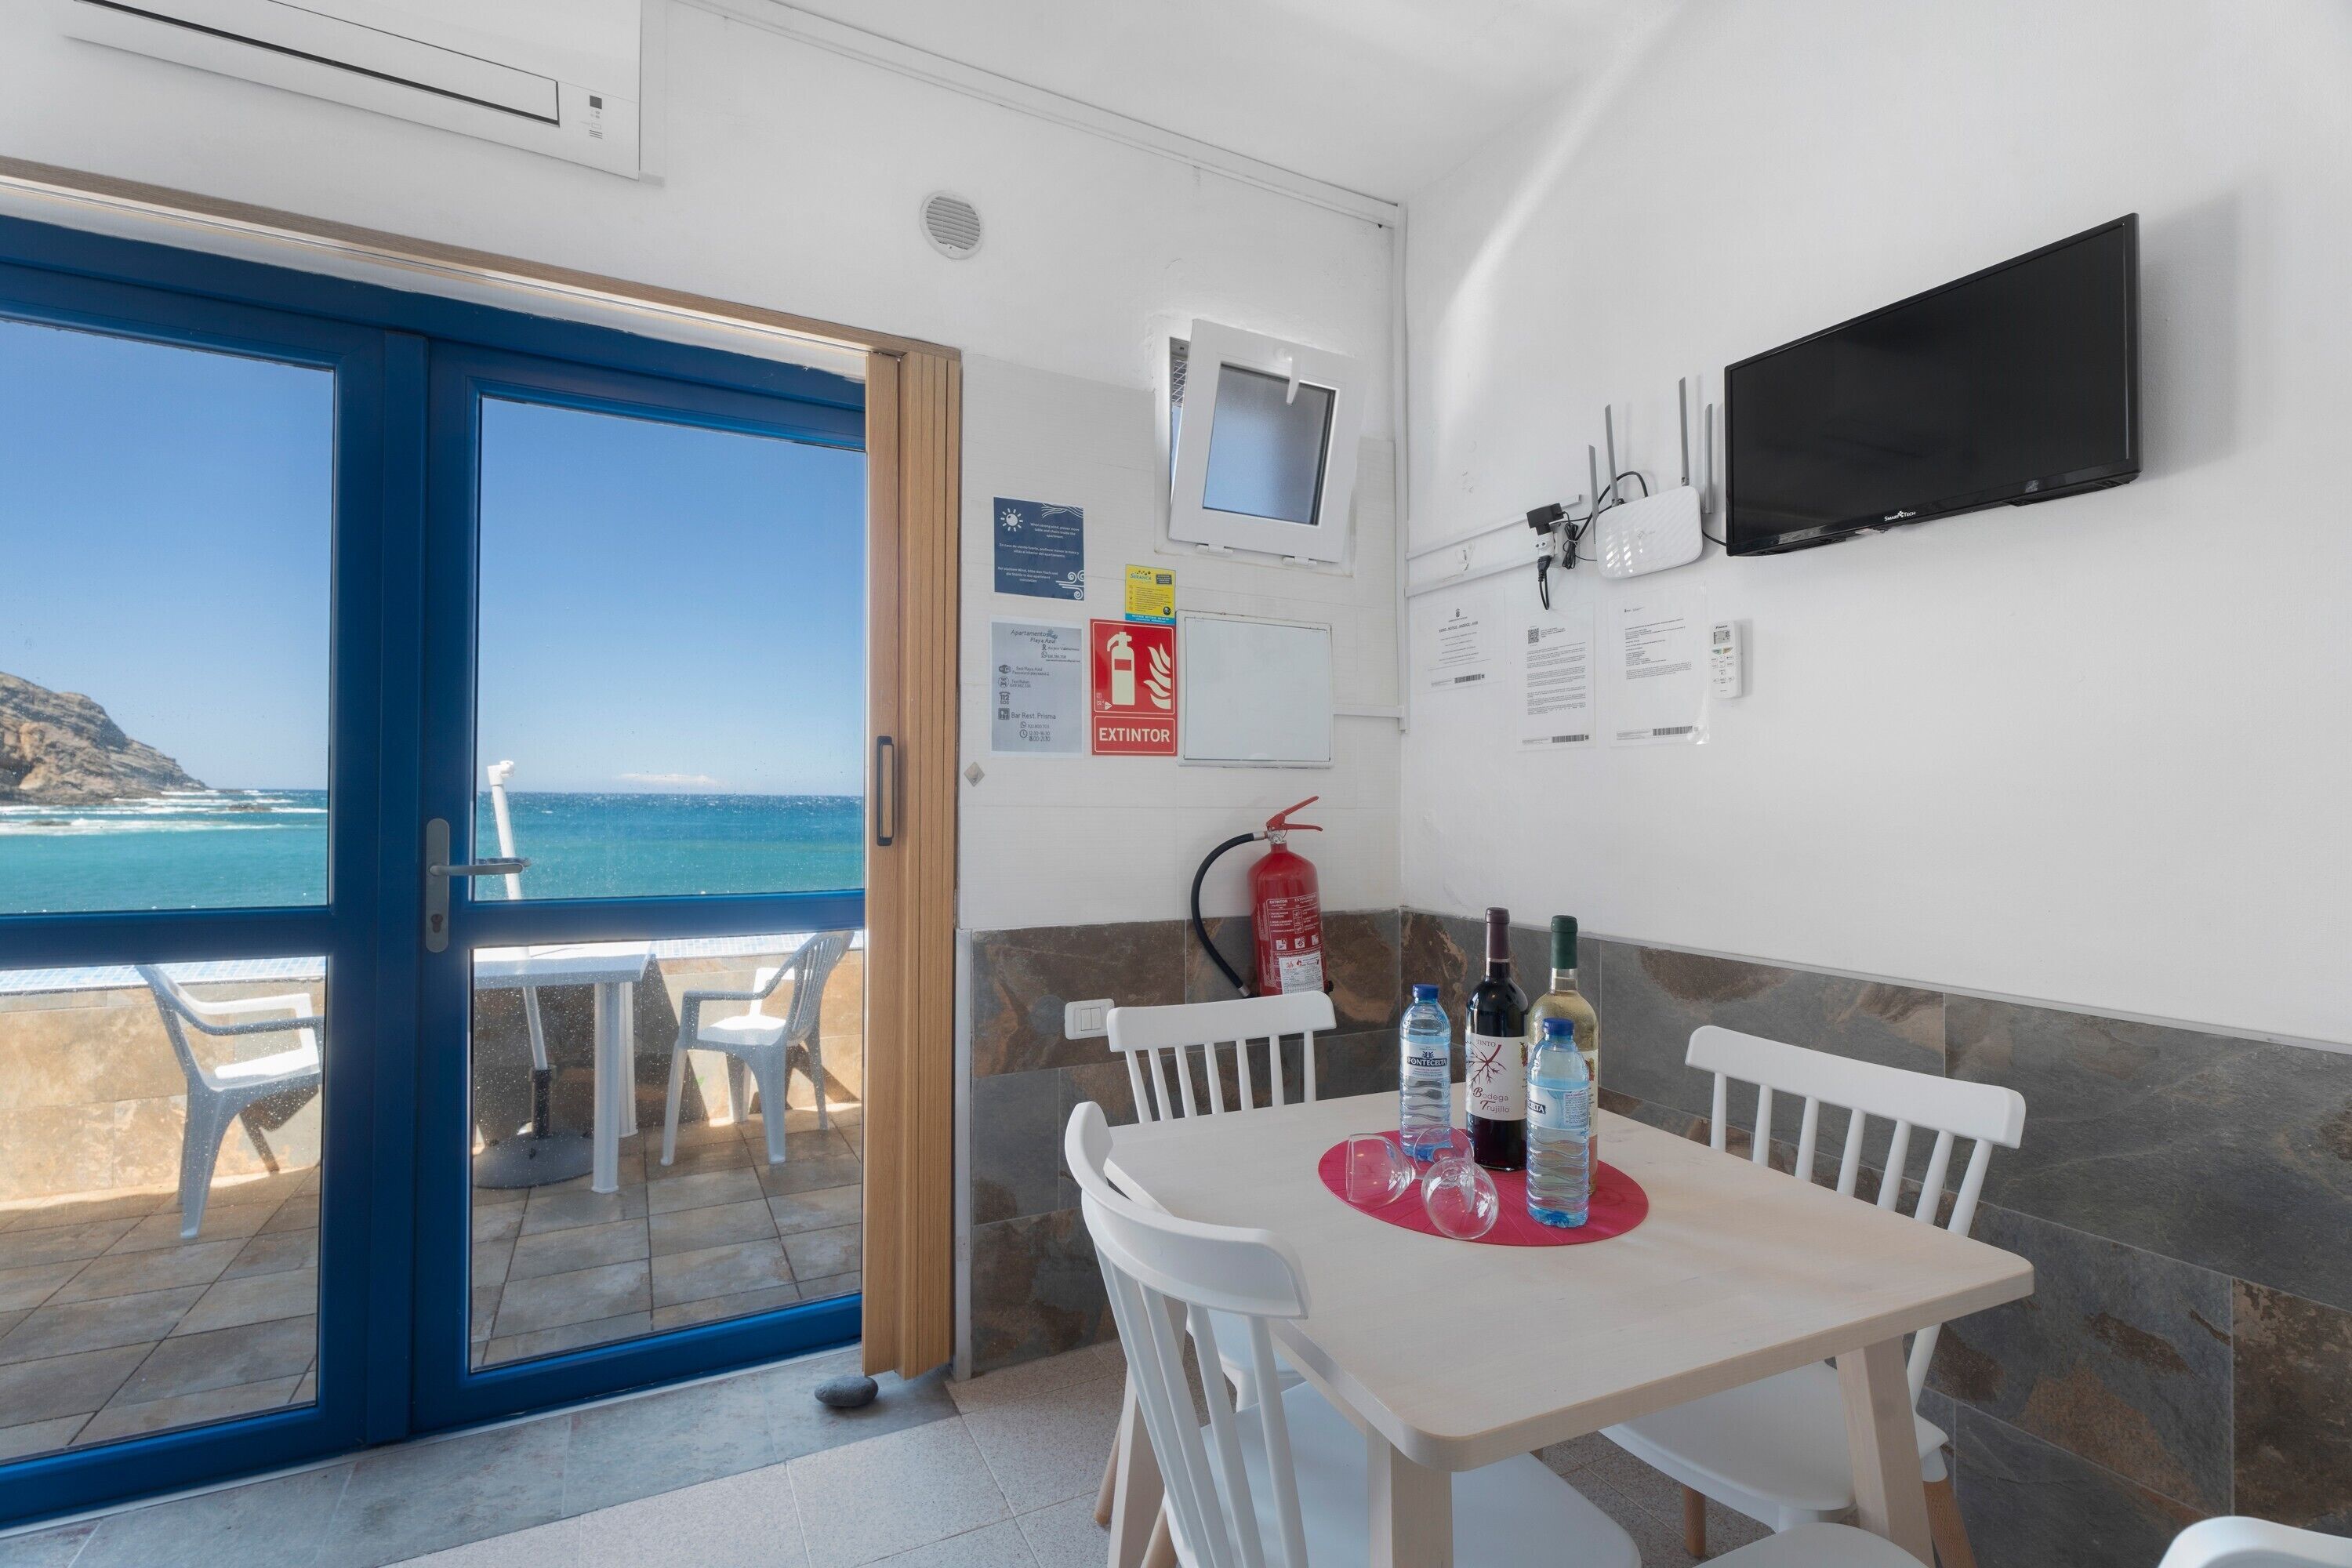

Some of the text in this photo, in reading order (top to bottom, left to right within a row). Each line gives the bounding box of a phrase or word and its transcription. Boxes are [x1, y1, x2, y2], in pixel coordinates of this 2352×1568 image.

[1099, 728, 1170, 742] EXTINTOR
[1473, 1087, 1508, 1102] Bodega
[1480, 1100, 1510, 1113] Trujillo
